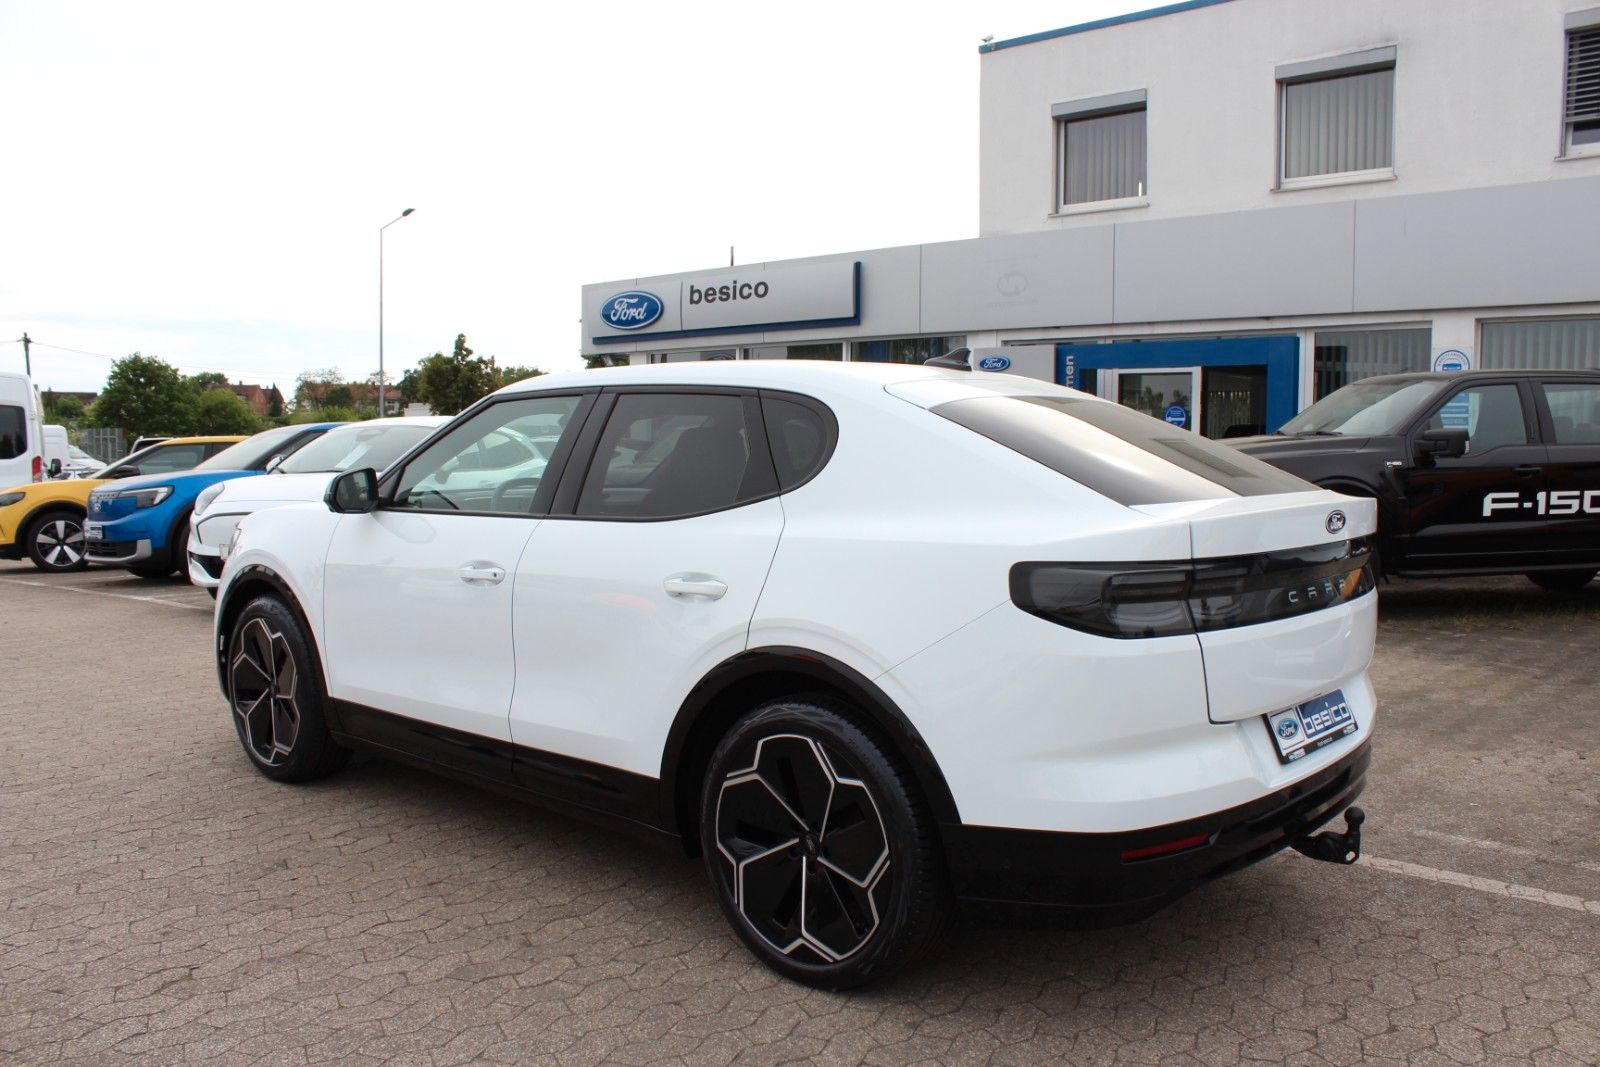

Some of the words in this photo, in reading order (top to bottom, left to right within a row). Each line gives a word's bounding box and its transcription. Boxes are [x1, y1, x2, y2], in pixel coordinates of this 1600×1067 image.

[689, 281, 769, 305] besico
[610, 298, 648, 321] Ford
[983, 358, 1003, 369] Ford
[1301, 701, 1350, 735] besico
